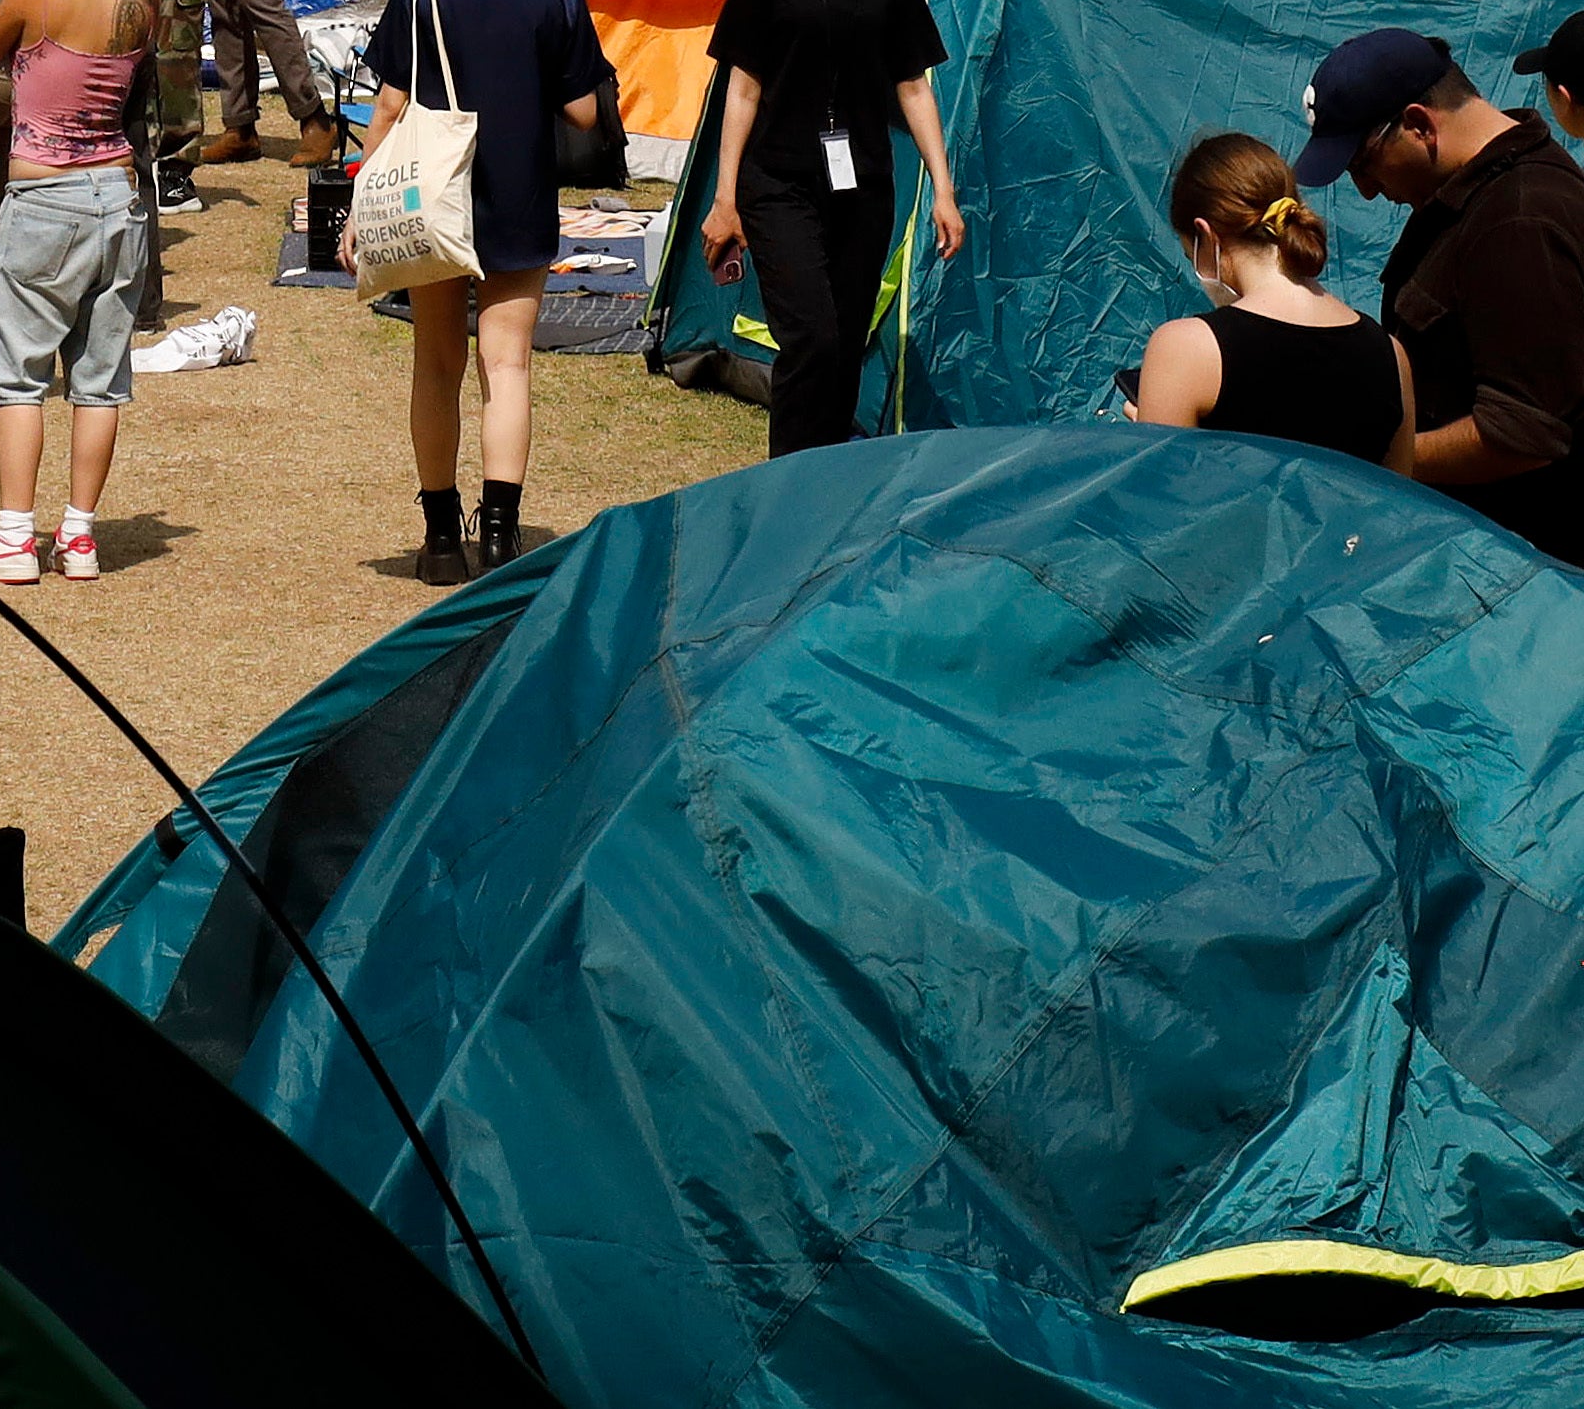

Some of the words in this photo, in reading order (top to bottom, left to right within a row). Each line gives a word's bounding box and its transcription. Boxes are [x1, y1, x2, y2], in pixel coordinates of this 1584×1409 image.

[389, 205, 403, 217] EN
[359, 216, 425, 245] SCIENCES
[363, 239, 432, 266] SOCIALES
